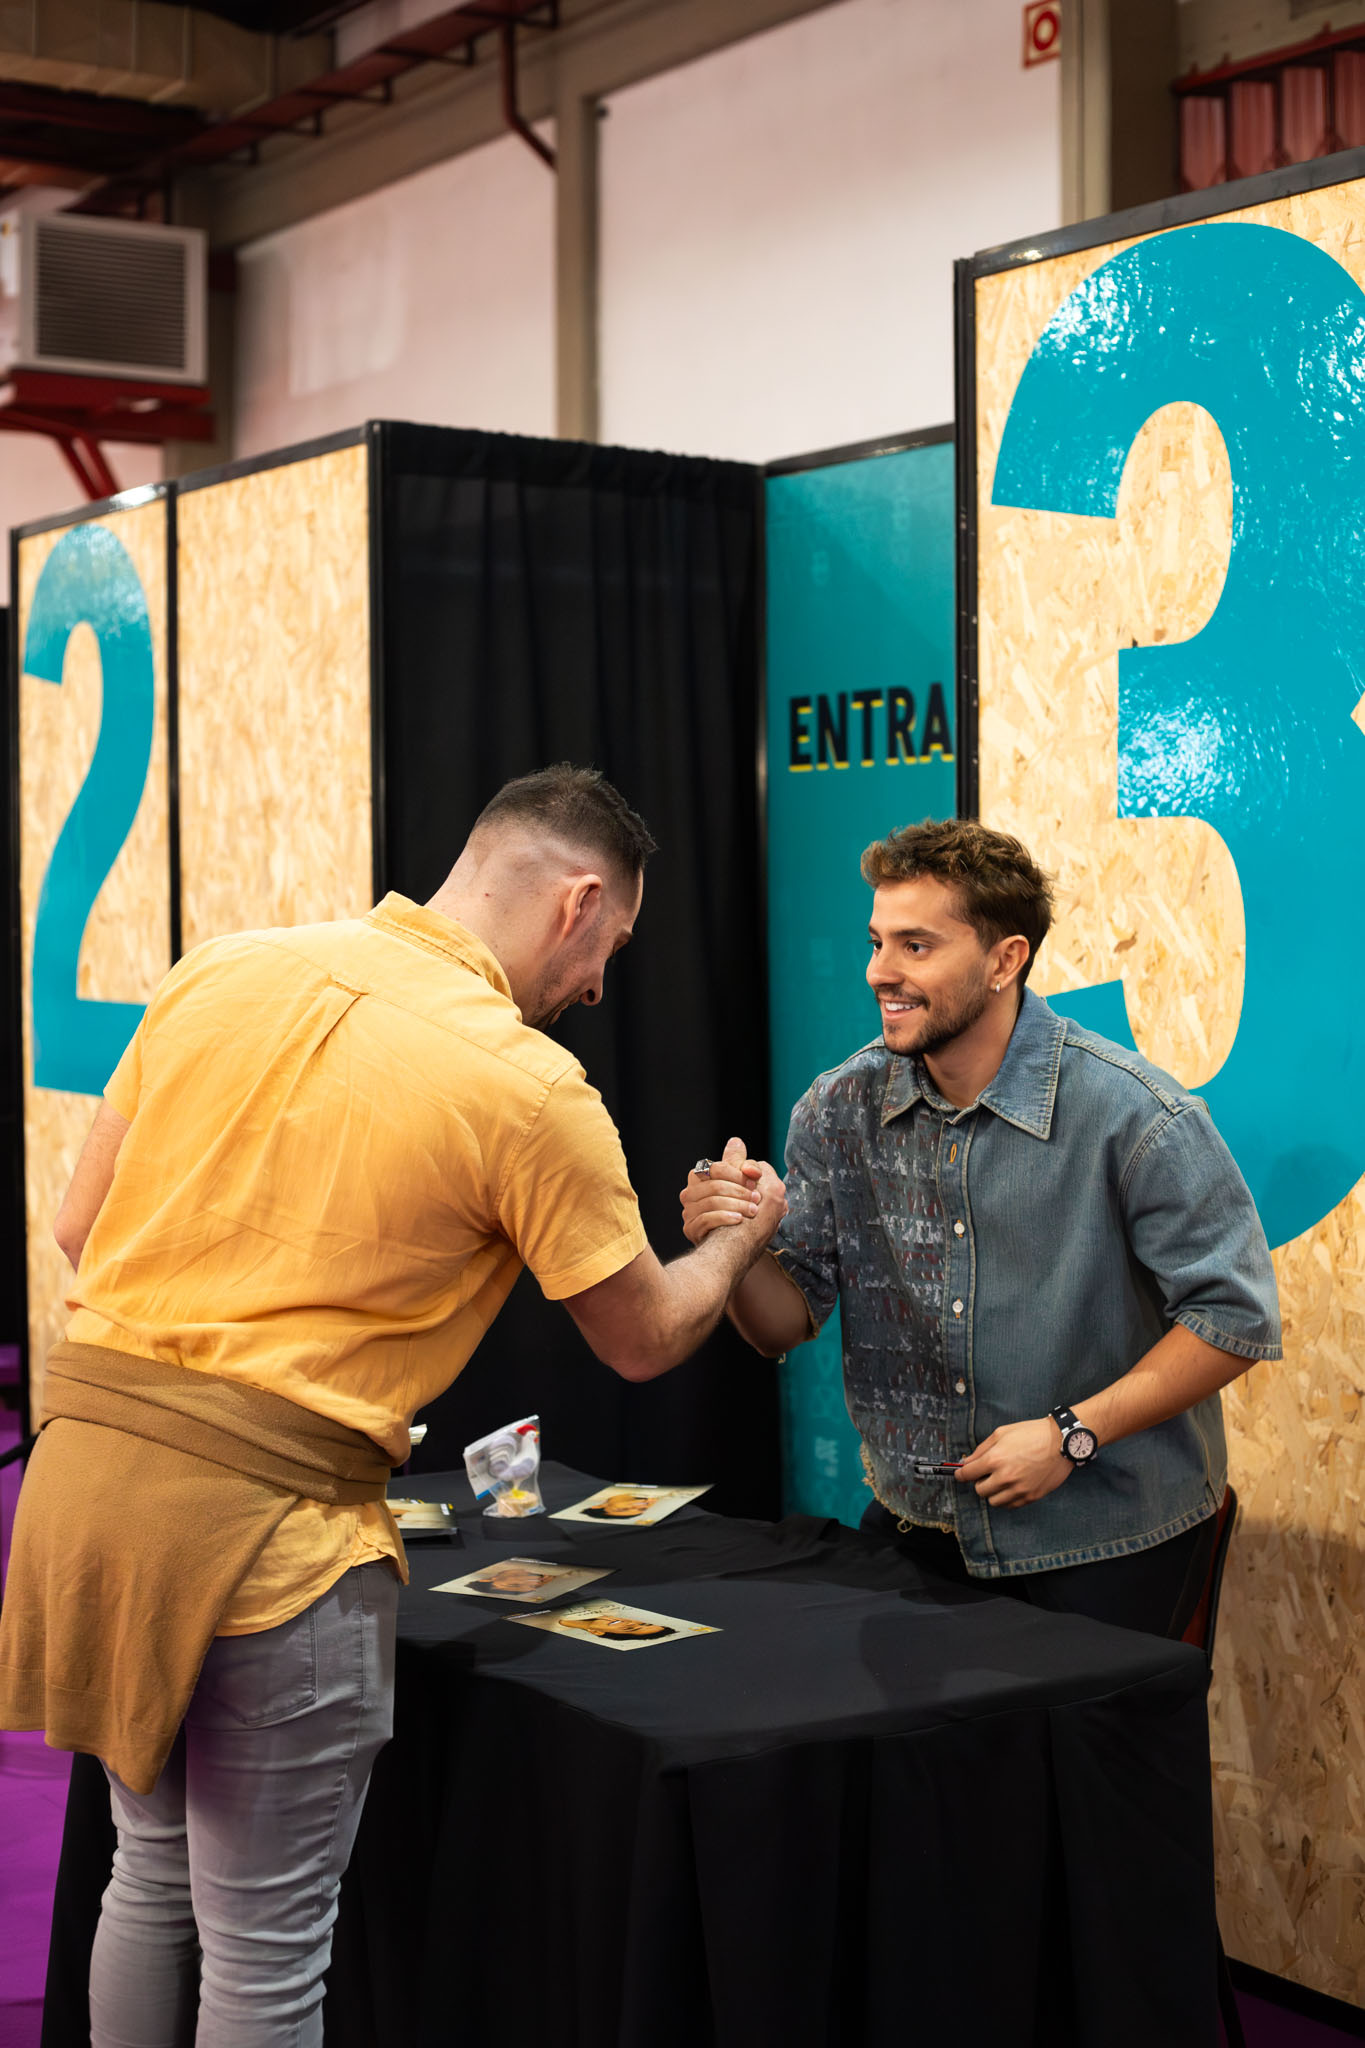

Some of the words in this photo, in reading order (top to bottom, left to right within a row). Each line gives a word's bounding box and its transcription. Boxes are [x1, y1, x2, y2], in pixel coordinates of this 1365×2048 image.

[23, 522, 155, 1097] 2
[788, 682, 955, 773] ENTRA
[992, 222, 1365, 1250] 3
